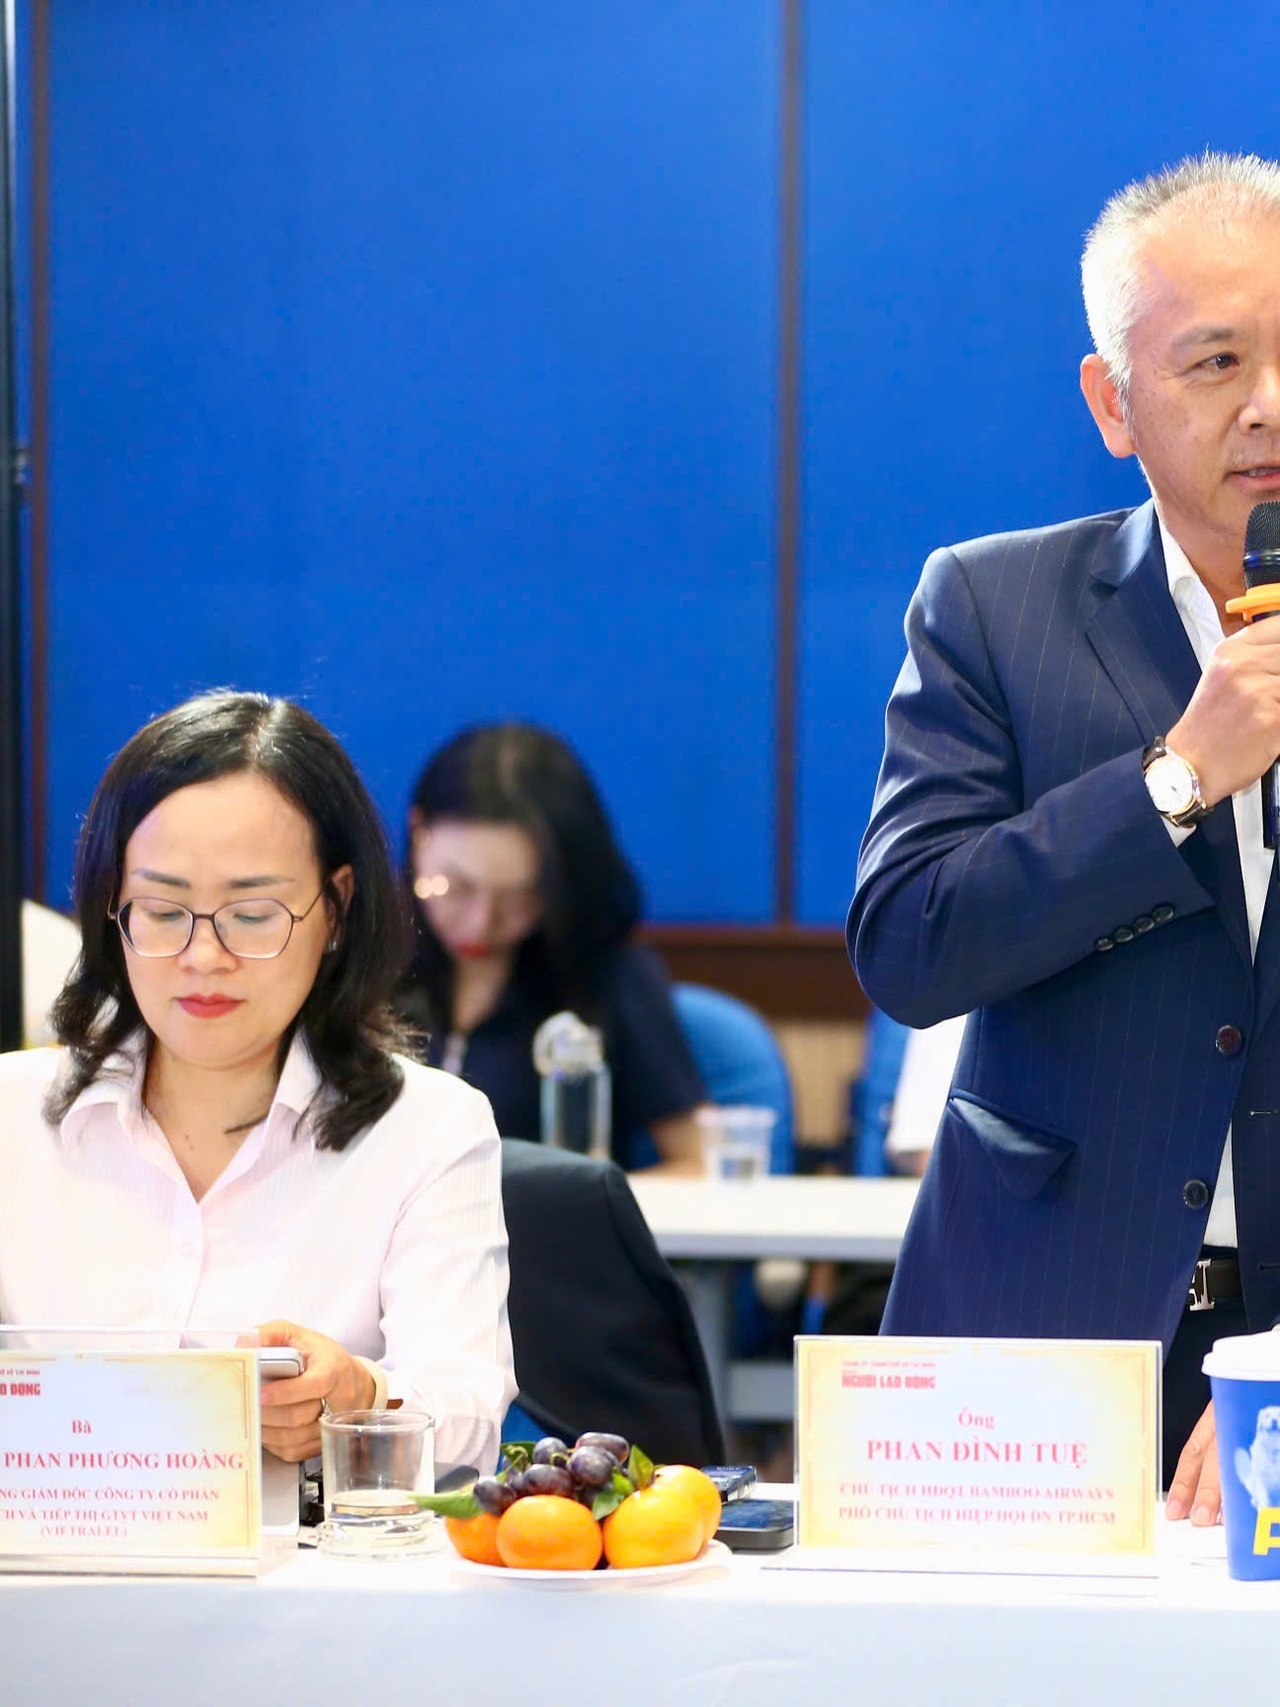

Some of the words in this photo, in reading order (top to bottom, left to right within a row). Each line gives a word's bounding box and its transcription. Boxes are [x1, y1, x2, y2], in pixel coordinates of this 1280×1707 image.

[879, 1374, 903, 1389] LAO
[71, 1419, 92, 1434] Bà
[957, 1407, 995, 1430] Ông
[4, 1451, 61, 1468] PHAN
[69, 1450, 159, 1470] PHƯƠNG
[166, 1447, 244, 1470] HOÀNG
[867, 1439, 942, 1461] PHAN
[952, 1436, 1022, 1463] ĐÌNH
[1031, 1442, 1088, 1469] TUỆ
[0, 1488, 17, 1500] NG
[94, 1485, 134, 1501] CÔNG
[139, 1488, 154, 1501] TY
[880, 1484, 917, 1499] TỊCH
[969, 1485, 1041, 1499] BAMBOO
[1043, 1486, 1115, 1501] AIRWAYS
[18, 1507, 37, 1521] VÀ
[141, 1509, 173, 1523] VIỆT
[177, 1510, 209, 1522] NAM
[914, 1507, 952, 1522] TỊCH
[1058, 1510, 1116, 1525] TP.HCM
